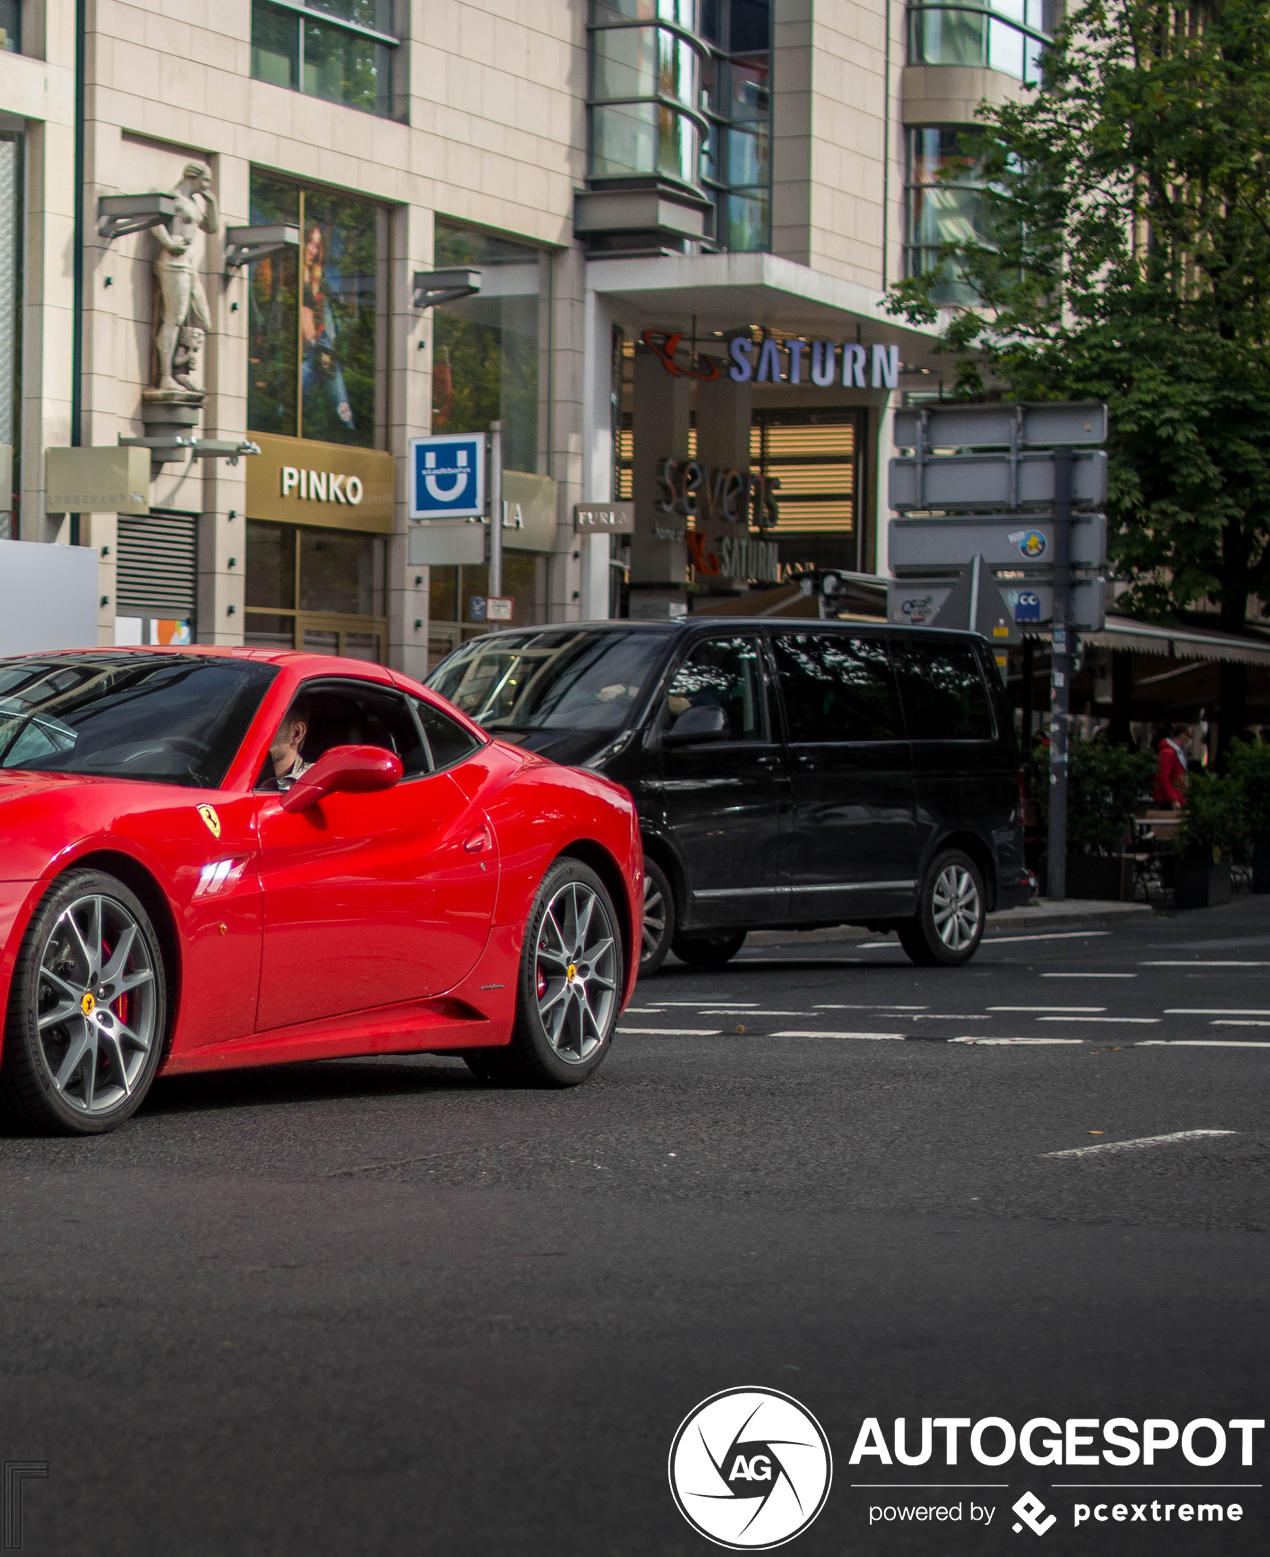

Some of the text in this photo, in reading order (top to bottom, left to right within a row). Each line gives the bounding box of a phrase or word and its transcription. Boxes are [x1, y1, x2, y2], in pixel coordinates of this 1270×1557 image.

[730, 336, 899, 389] SATURN
[281, 466, 364, 506] PINKO
[421, 466, 471, 476] stadtbahn
[658, 458, 782, 528] sevens
[578, 511, 628, 525] FURLA
[721, 535, 779, 578] SATURN
